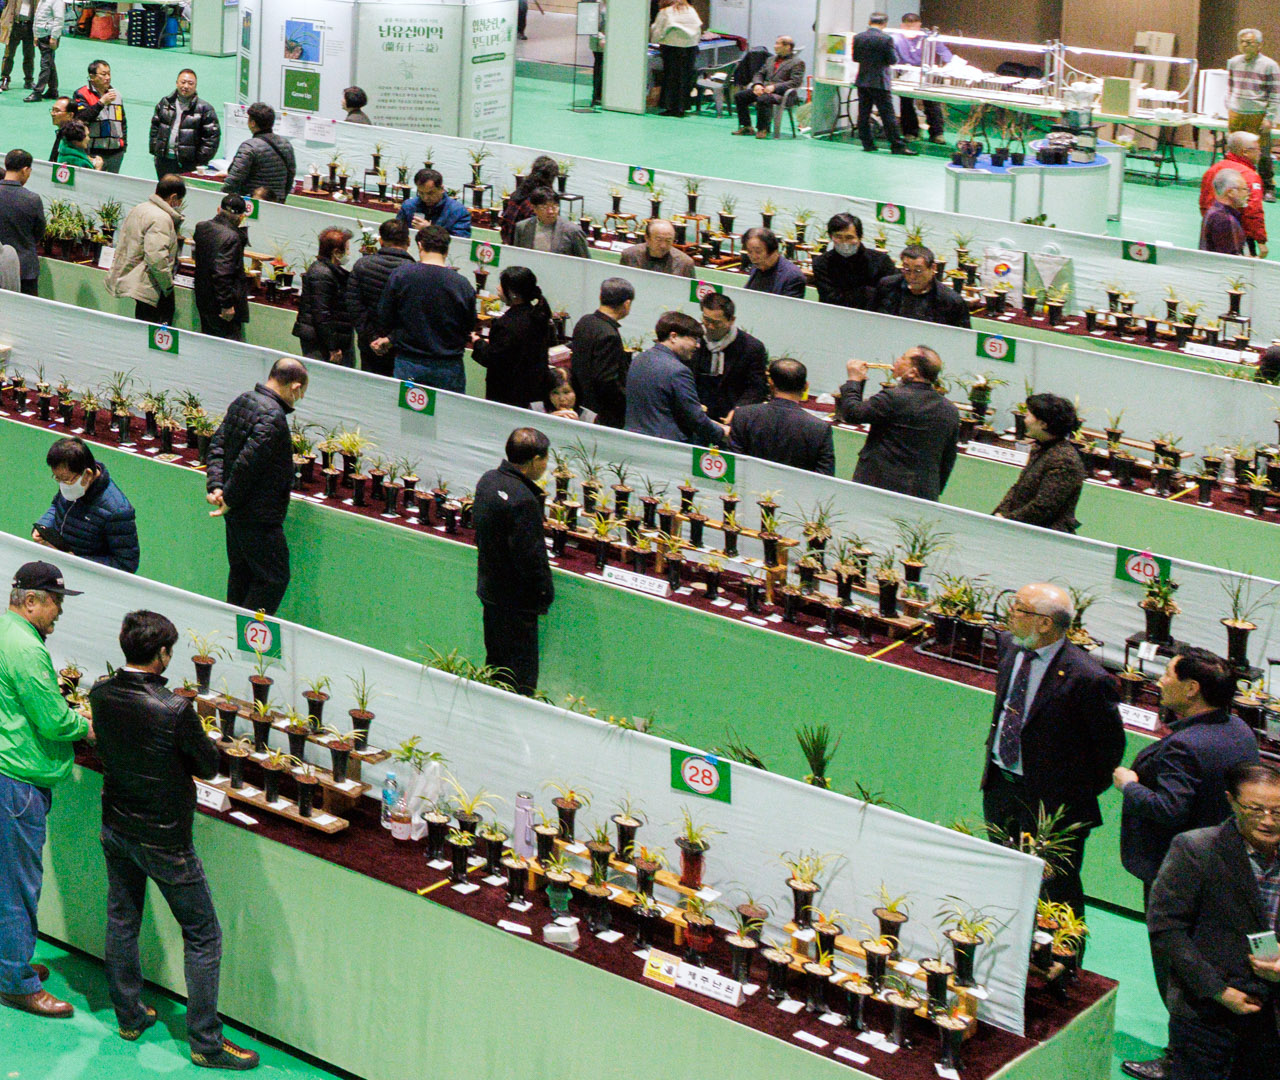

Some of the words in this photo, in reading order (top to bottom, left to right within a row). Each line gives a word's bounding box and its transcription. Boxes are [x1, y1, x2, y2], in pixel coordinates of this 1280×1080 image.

[58, 171, 69, 180] 47
[888, 209, 894, 219] 3
[158, 332, 171, 346] 37
[989, 341, 1003, 354] 51
[409, 391, 425, 406] 38
[704, 457, 724, 473] 39
[1131, 561, 1155, 578] 40
[250, 627, 268, 645] 27
[689, 765, 714, 787] 28
